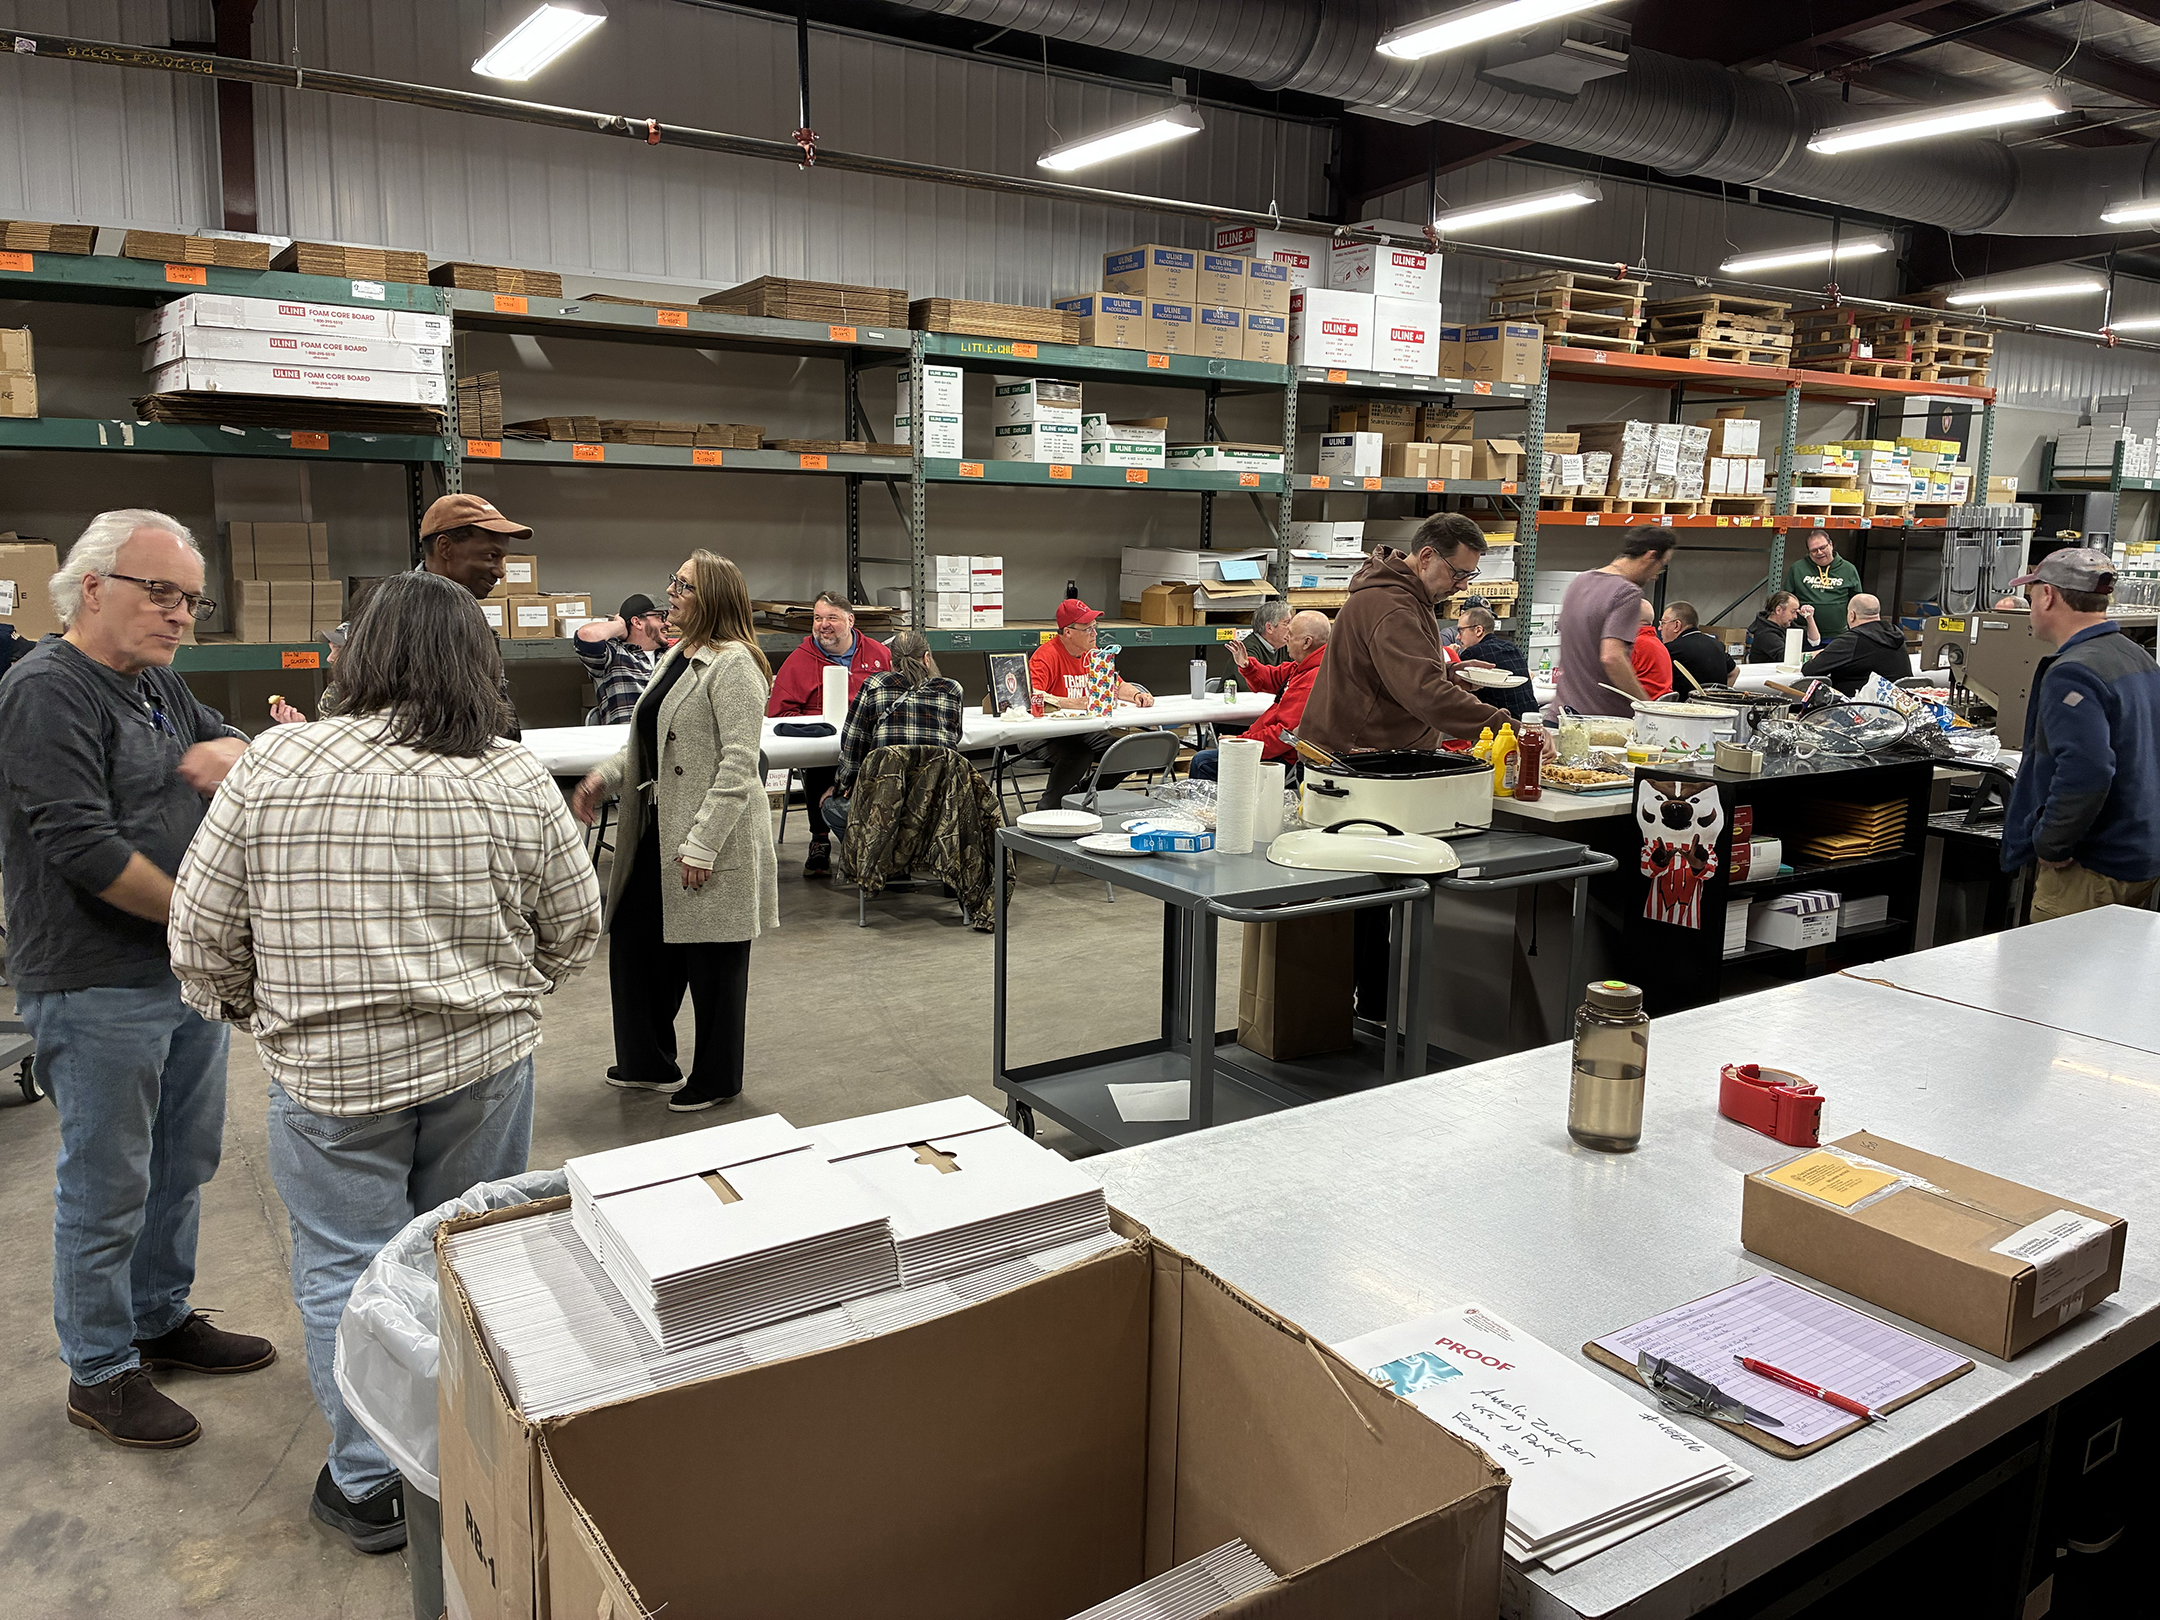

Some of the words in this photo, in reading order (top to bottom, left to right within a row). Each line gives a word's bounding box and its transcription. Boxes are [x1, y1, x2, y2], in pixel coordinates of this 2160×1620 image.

[1218, 230, 1243, 246] ULINE
[1244, 228, 1254, 240] AIR
[1118, 254, 1133, 264] ULINE
[1166, 252, 1182, 260] ULINE
[1274, 253, 1298, 266] ULINE
[1298, 258, 1308, 266] AIR
[1393, 254, 1416, 266] ULINE
[1216, 258, 1232, 266] ULINE
[1114, 300, 1130, 308] ULINE
[1292, 298, 1302, 308] AIR
[280, 306, 305, 316] ULINE
[1324, 323, 1346, 334] ULINE
[1392, 330, 1414, 341] ULINE
[271, 339, 296, 348] ULINE
[274, 370, 299, 378] ULINE
[1434, 1337, 1516, 1371] PROOF
[1452, 1411, 1491, 1442] Room
[1498, 1443, 1534, 1465] 3211
[1521, 1433, 1561, 1458] Park
